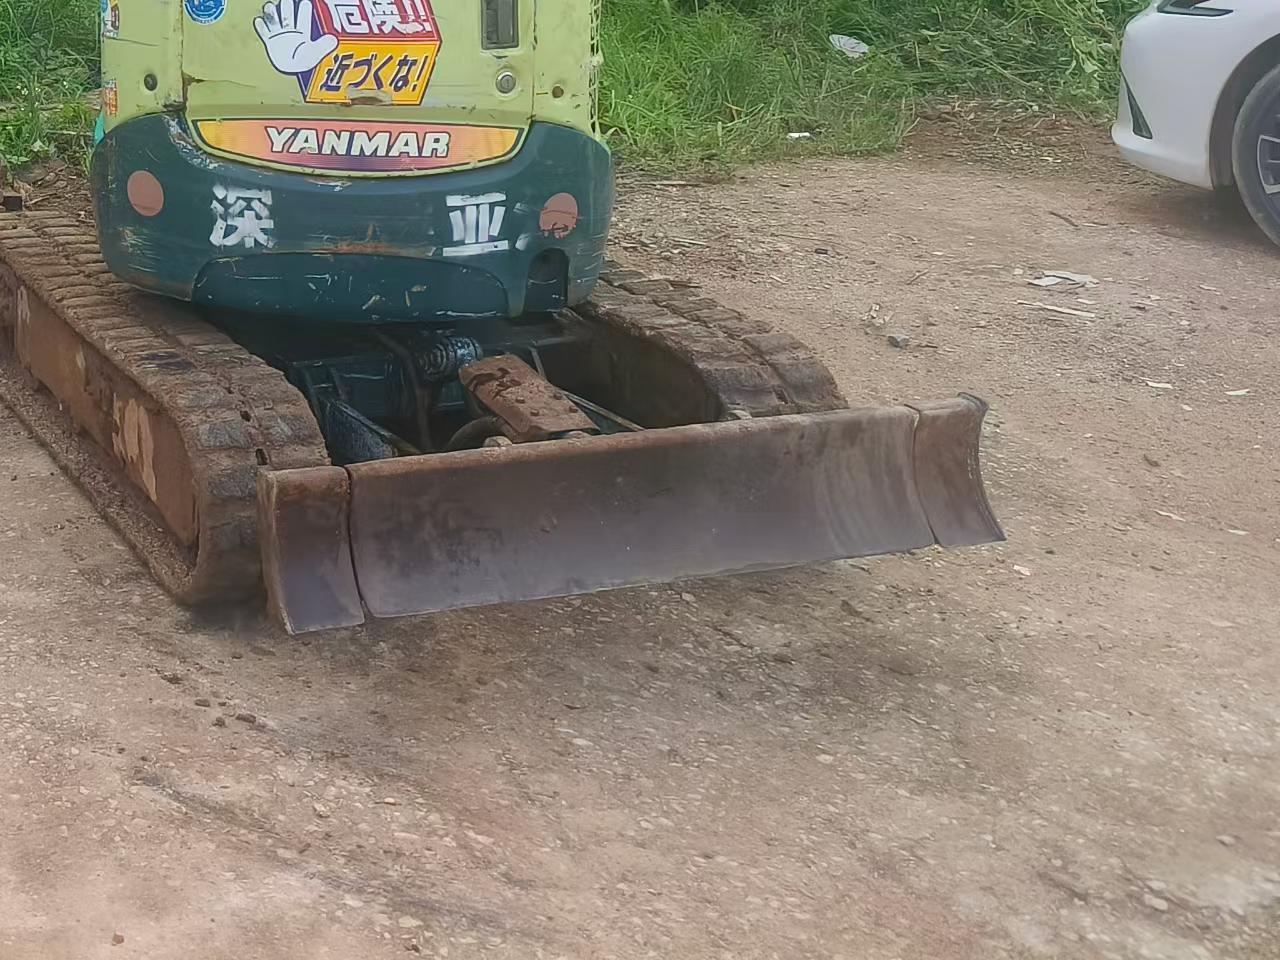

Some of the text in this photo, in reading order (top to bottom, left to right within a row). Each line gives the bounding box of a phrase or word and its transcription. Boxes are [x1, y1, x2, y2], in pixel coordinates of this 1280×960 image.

[320, 53, 429, 93] 近づくな!
[265, 126, 450, 158] YANMAR
[208, 185, 275, 249] 深
